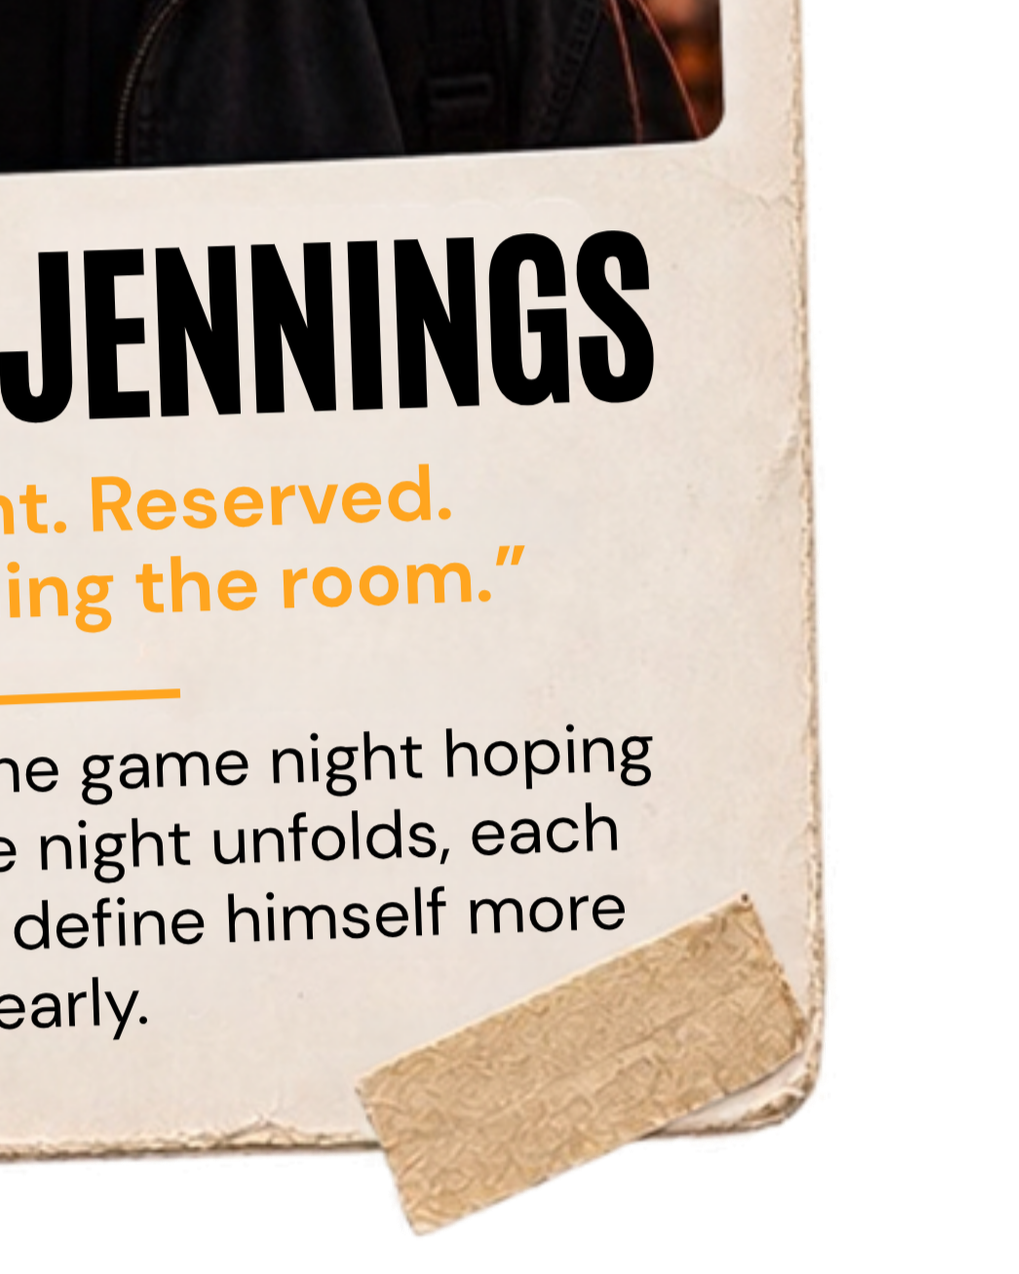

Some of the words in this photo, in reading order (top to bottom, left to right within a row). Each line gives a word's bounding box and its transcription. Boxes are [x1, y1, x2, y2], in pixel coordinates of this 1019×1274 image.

[91, 463, 452, 532] Reserved.
[135, 555, 258, 614] the
[282, 544, 526, 609] room.”
[81, 749, 249, 806] game
[272, 730, 423, 797] night
[445, 723, 653, 790] hoping
[40, 817, 191, 884] night
[213, 808, 450, 865] unfolds,
[471, 802, 618, 856] each
[13, 896, 205, 951] define
[227, 885, 447, 943] himself
[469, 894, 626, 935] more
